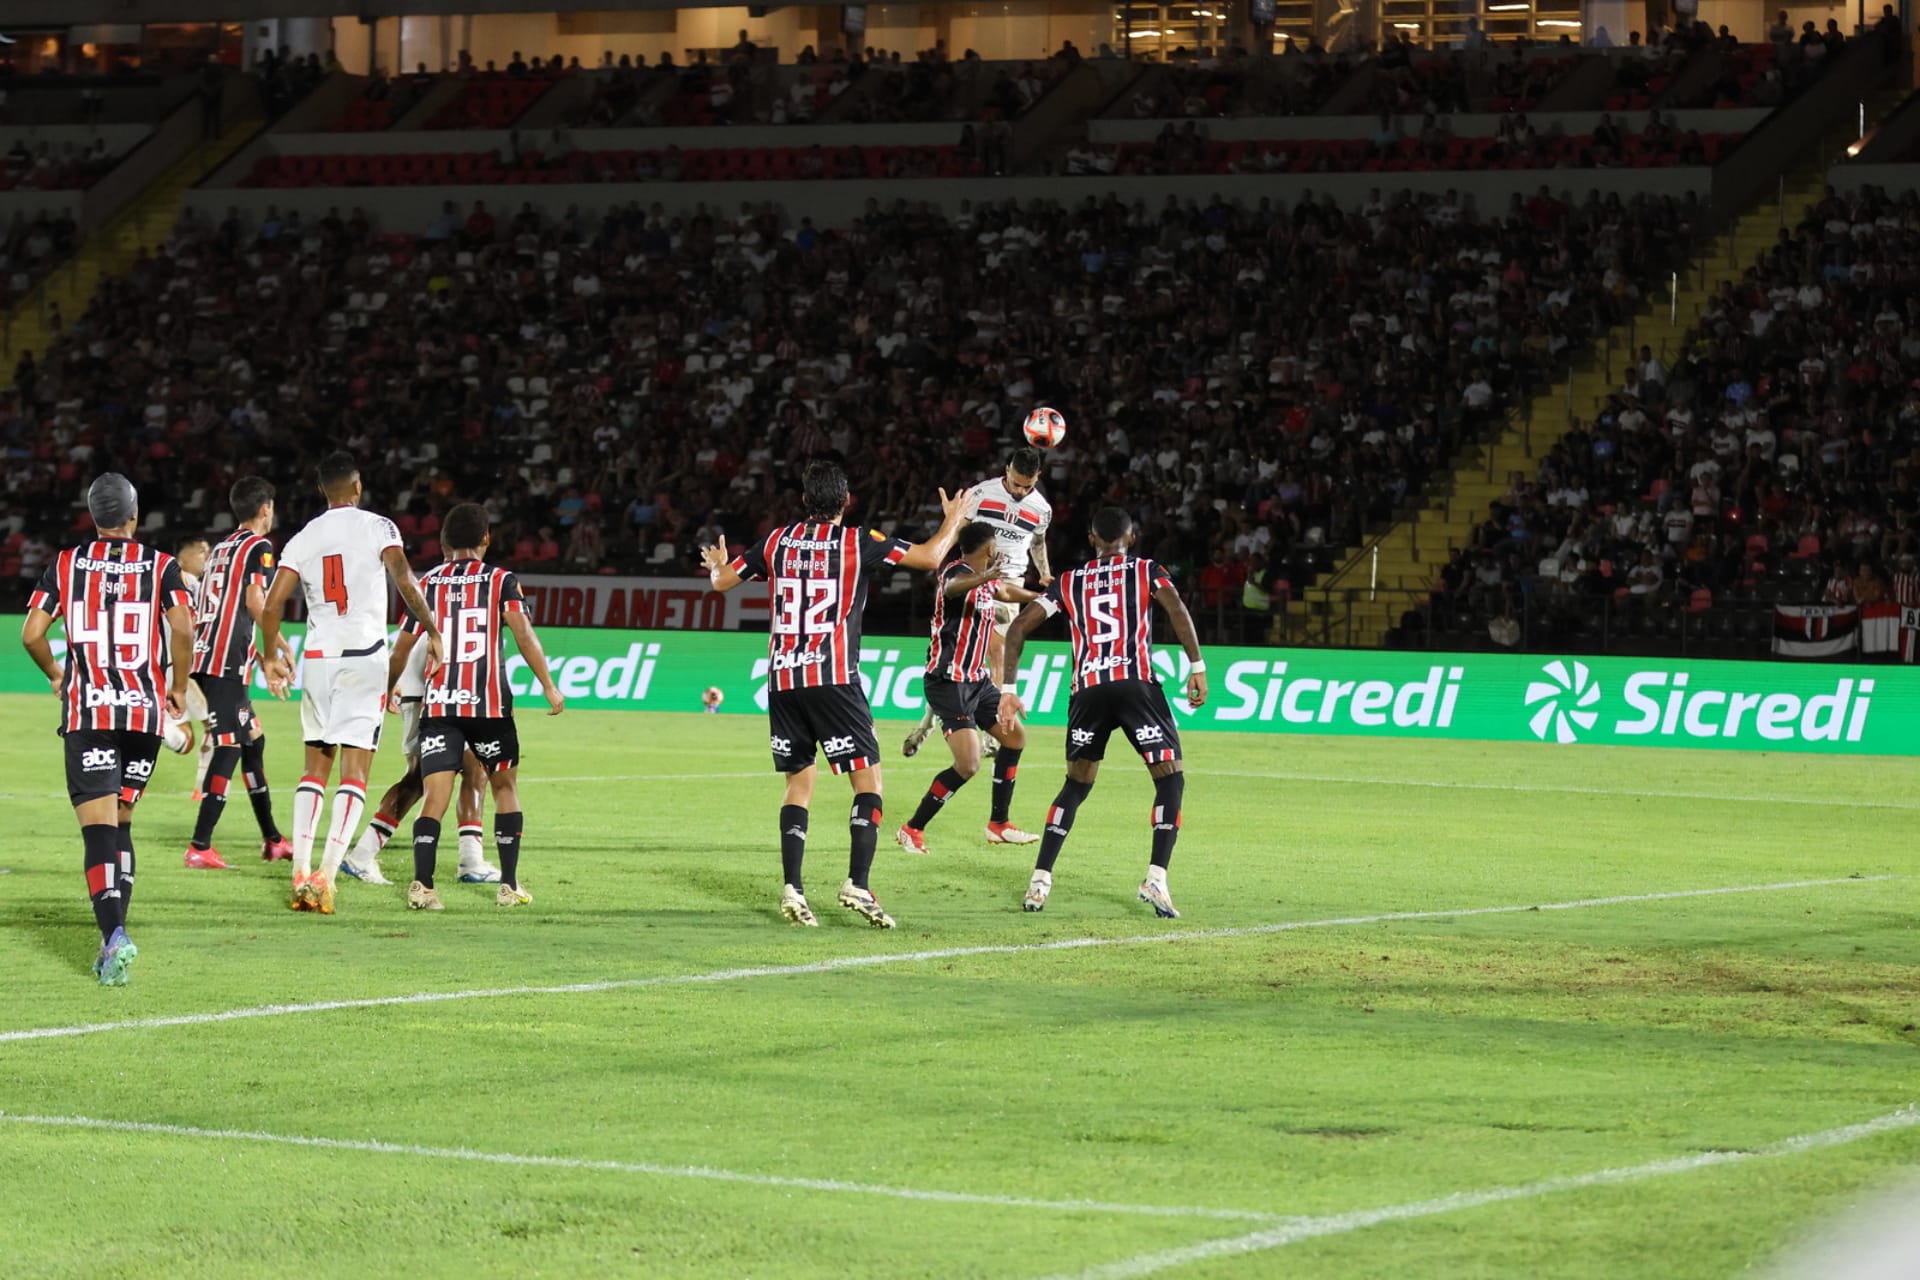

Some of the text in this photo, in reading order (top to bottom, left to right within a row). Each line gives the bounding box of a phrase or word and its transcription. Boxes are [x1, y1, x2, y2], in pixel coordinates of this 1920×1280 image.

[781, 536, 839, 550] SUPERBET
[75, 557, 152, 575] SUPERBET
[1075, 561, 1136, 577] SUPERBET
[322, 554, 348, 616] 4
[428, 572, 490, 585] SUPERBET
[774, 578, 838, 635] 32
[1089, 593, 1121, 645] 5
[72, 600, 151, 671] 49
[504, 642, 662, 700] credi
[859, 649, 1068, 713] icdi
[1214, 660, 1465, 728] Sicredi
[1614, 671, 1876, 742] Sicredi
[1135, 724, 1163, 741] abc
[420, 734, 446, 754] abc
[823, 735, 855, 753] abc
[82, 747, 116, 768] abc
[125, 758, 155, 777] ab
